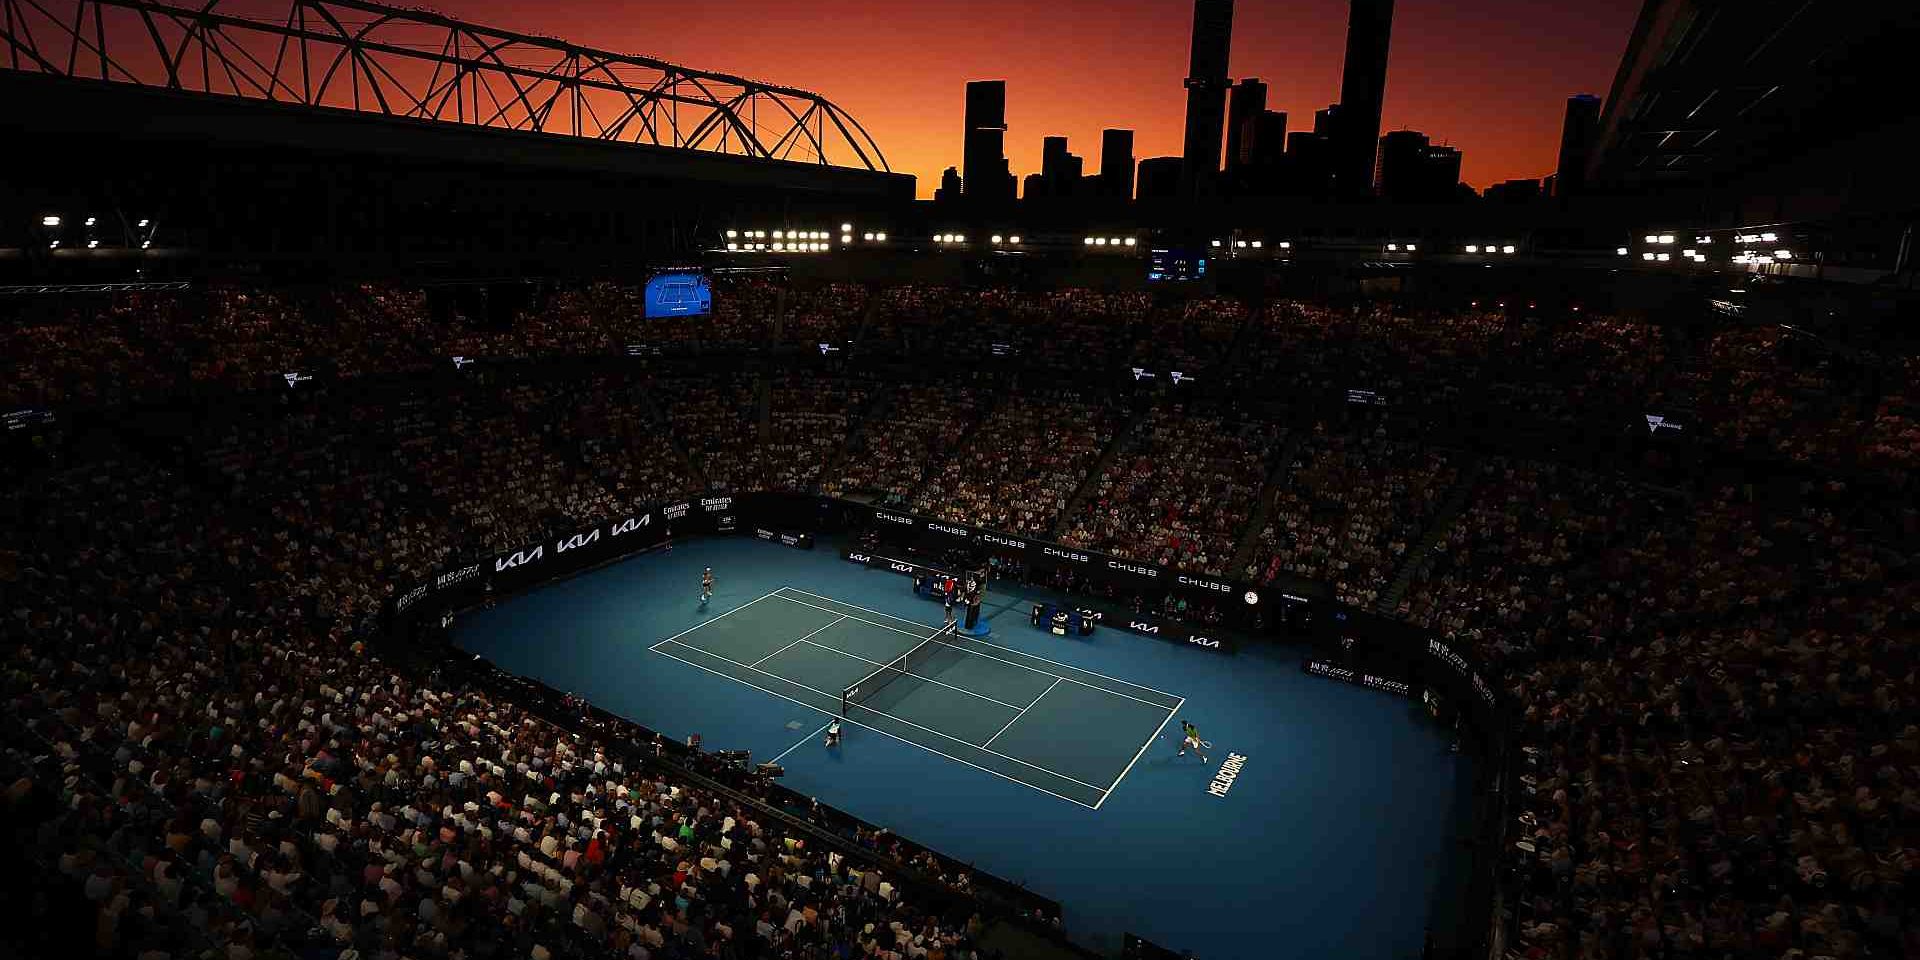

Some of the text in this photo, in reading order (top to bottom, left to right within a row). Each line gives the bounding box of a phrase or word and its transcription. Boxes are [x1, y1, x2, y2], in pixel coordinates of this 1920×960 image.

[701, 497, 732, 506] Emirates
[612, 513, 650, 537] KIA
[876, 512, 913, 525] CHUBB
[928, 523, 968, 536] CHUBB
[557, 528, 600, 553] KIA
[984, 534, 1025, 549] CHUBB
[495, 544, 543, 572] KIA
[849, 552, 871, 564] KIA
[1043, 547, 1089, 562] CHUBB
[891, 562, 913, 574] KIA
[1107, 561, 1158, 577] CHUBB
[1177, 576, 1232, 592] CHUBB
[1130, 620, 1159, 634] KIA
[1189, 635, 1220, 648] KIA
[1207, 751, 1248, 798] MELBOURNE
